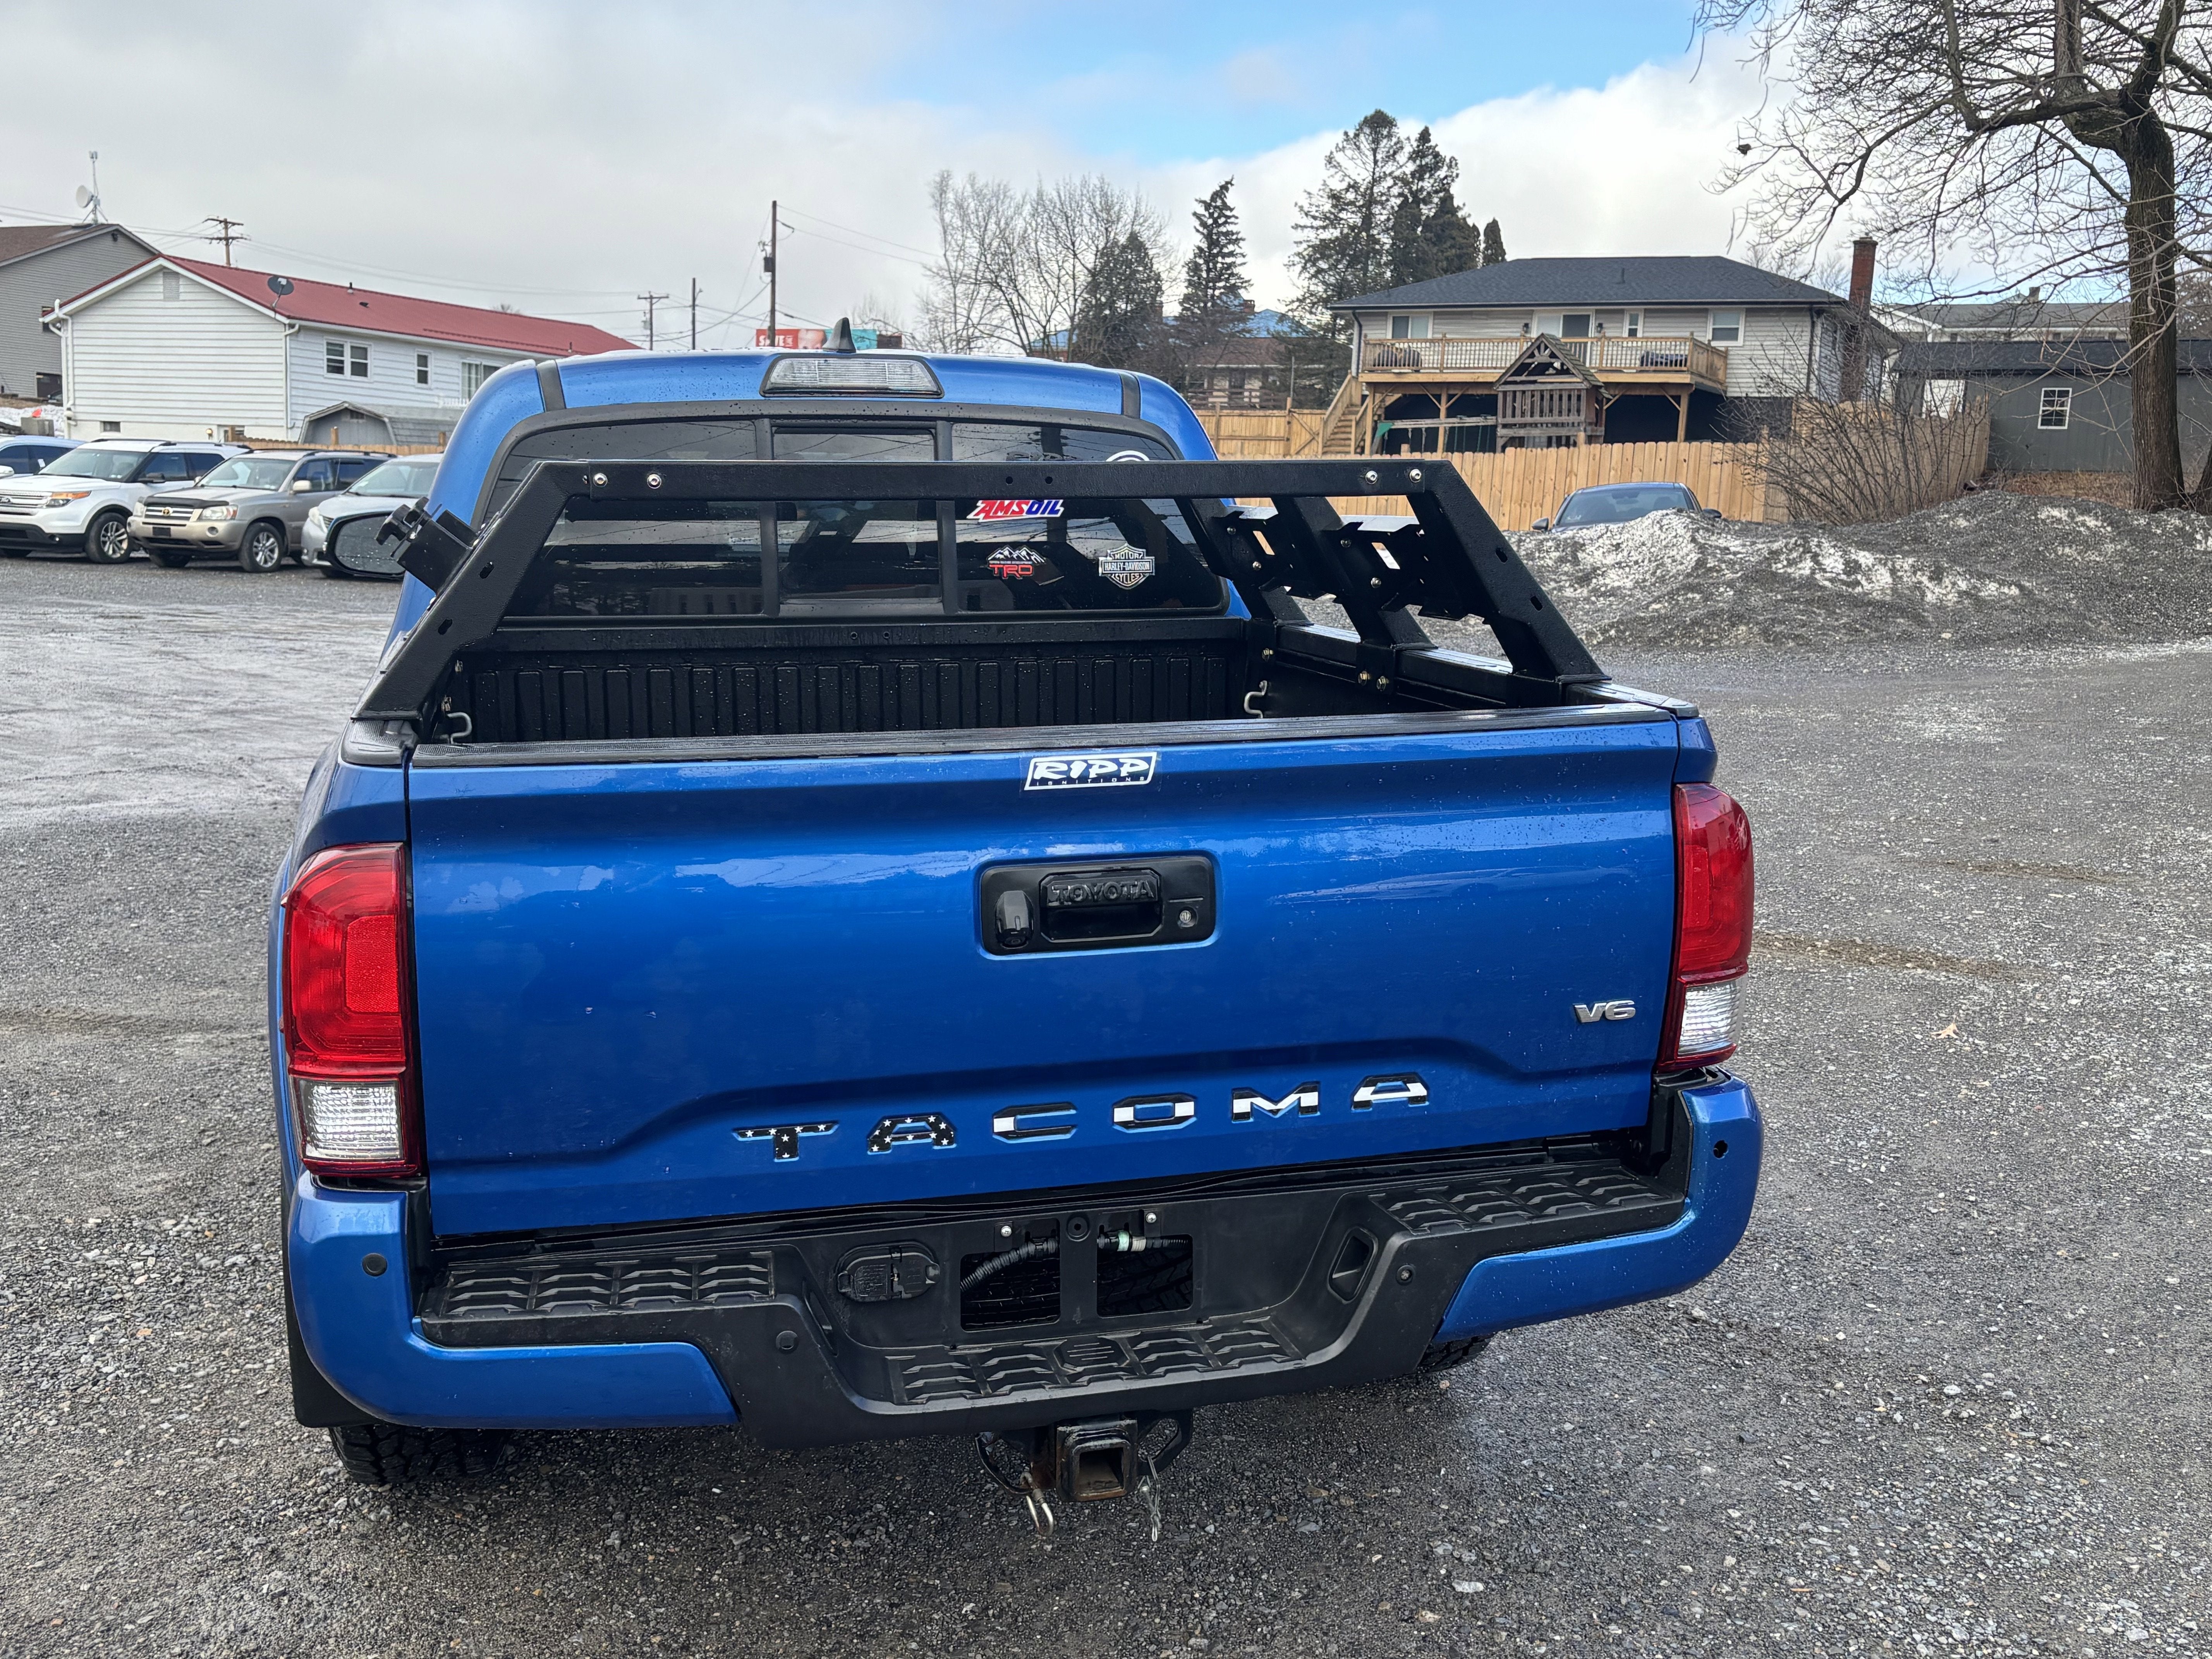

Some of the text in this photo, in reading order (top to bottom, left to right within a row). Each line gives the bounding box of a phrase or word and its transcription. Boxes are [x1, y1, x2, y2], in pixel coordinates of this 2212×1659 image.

[759, 335, 785, 346] SE
[972, 500, 1061, 520] AMSOIL
[1115, 550, 1139, 560] MOTOR
[989, 564, 1033, 578] TRD
[1104, 562, 1150, 571] HARLEY-DAVIDSON
[1115, 573, 1140, 584] CYCLES
[1033, 758, 1149, 780] RIPP
[1036, 776, 1145, 786] IGNITIONS
[1051, 880, 1154, 903] TOYOTA
[1573, 999, 1636, 1023] V6
[733, 1072, 1430, 1162] TACOMA
